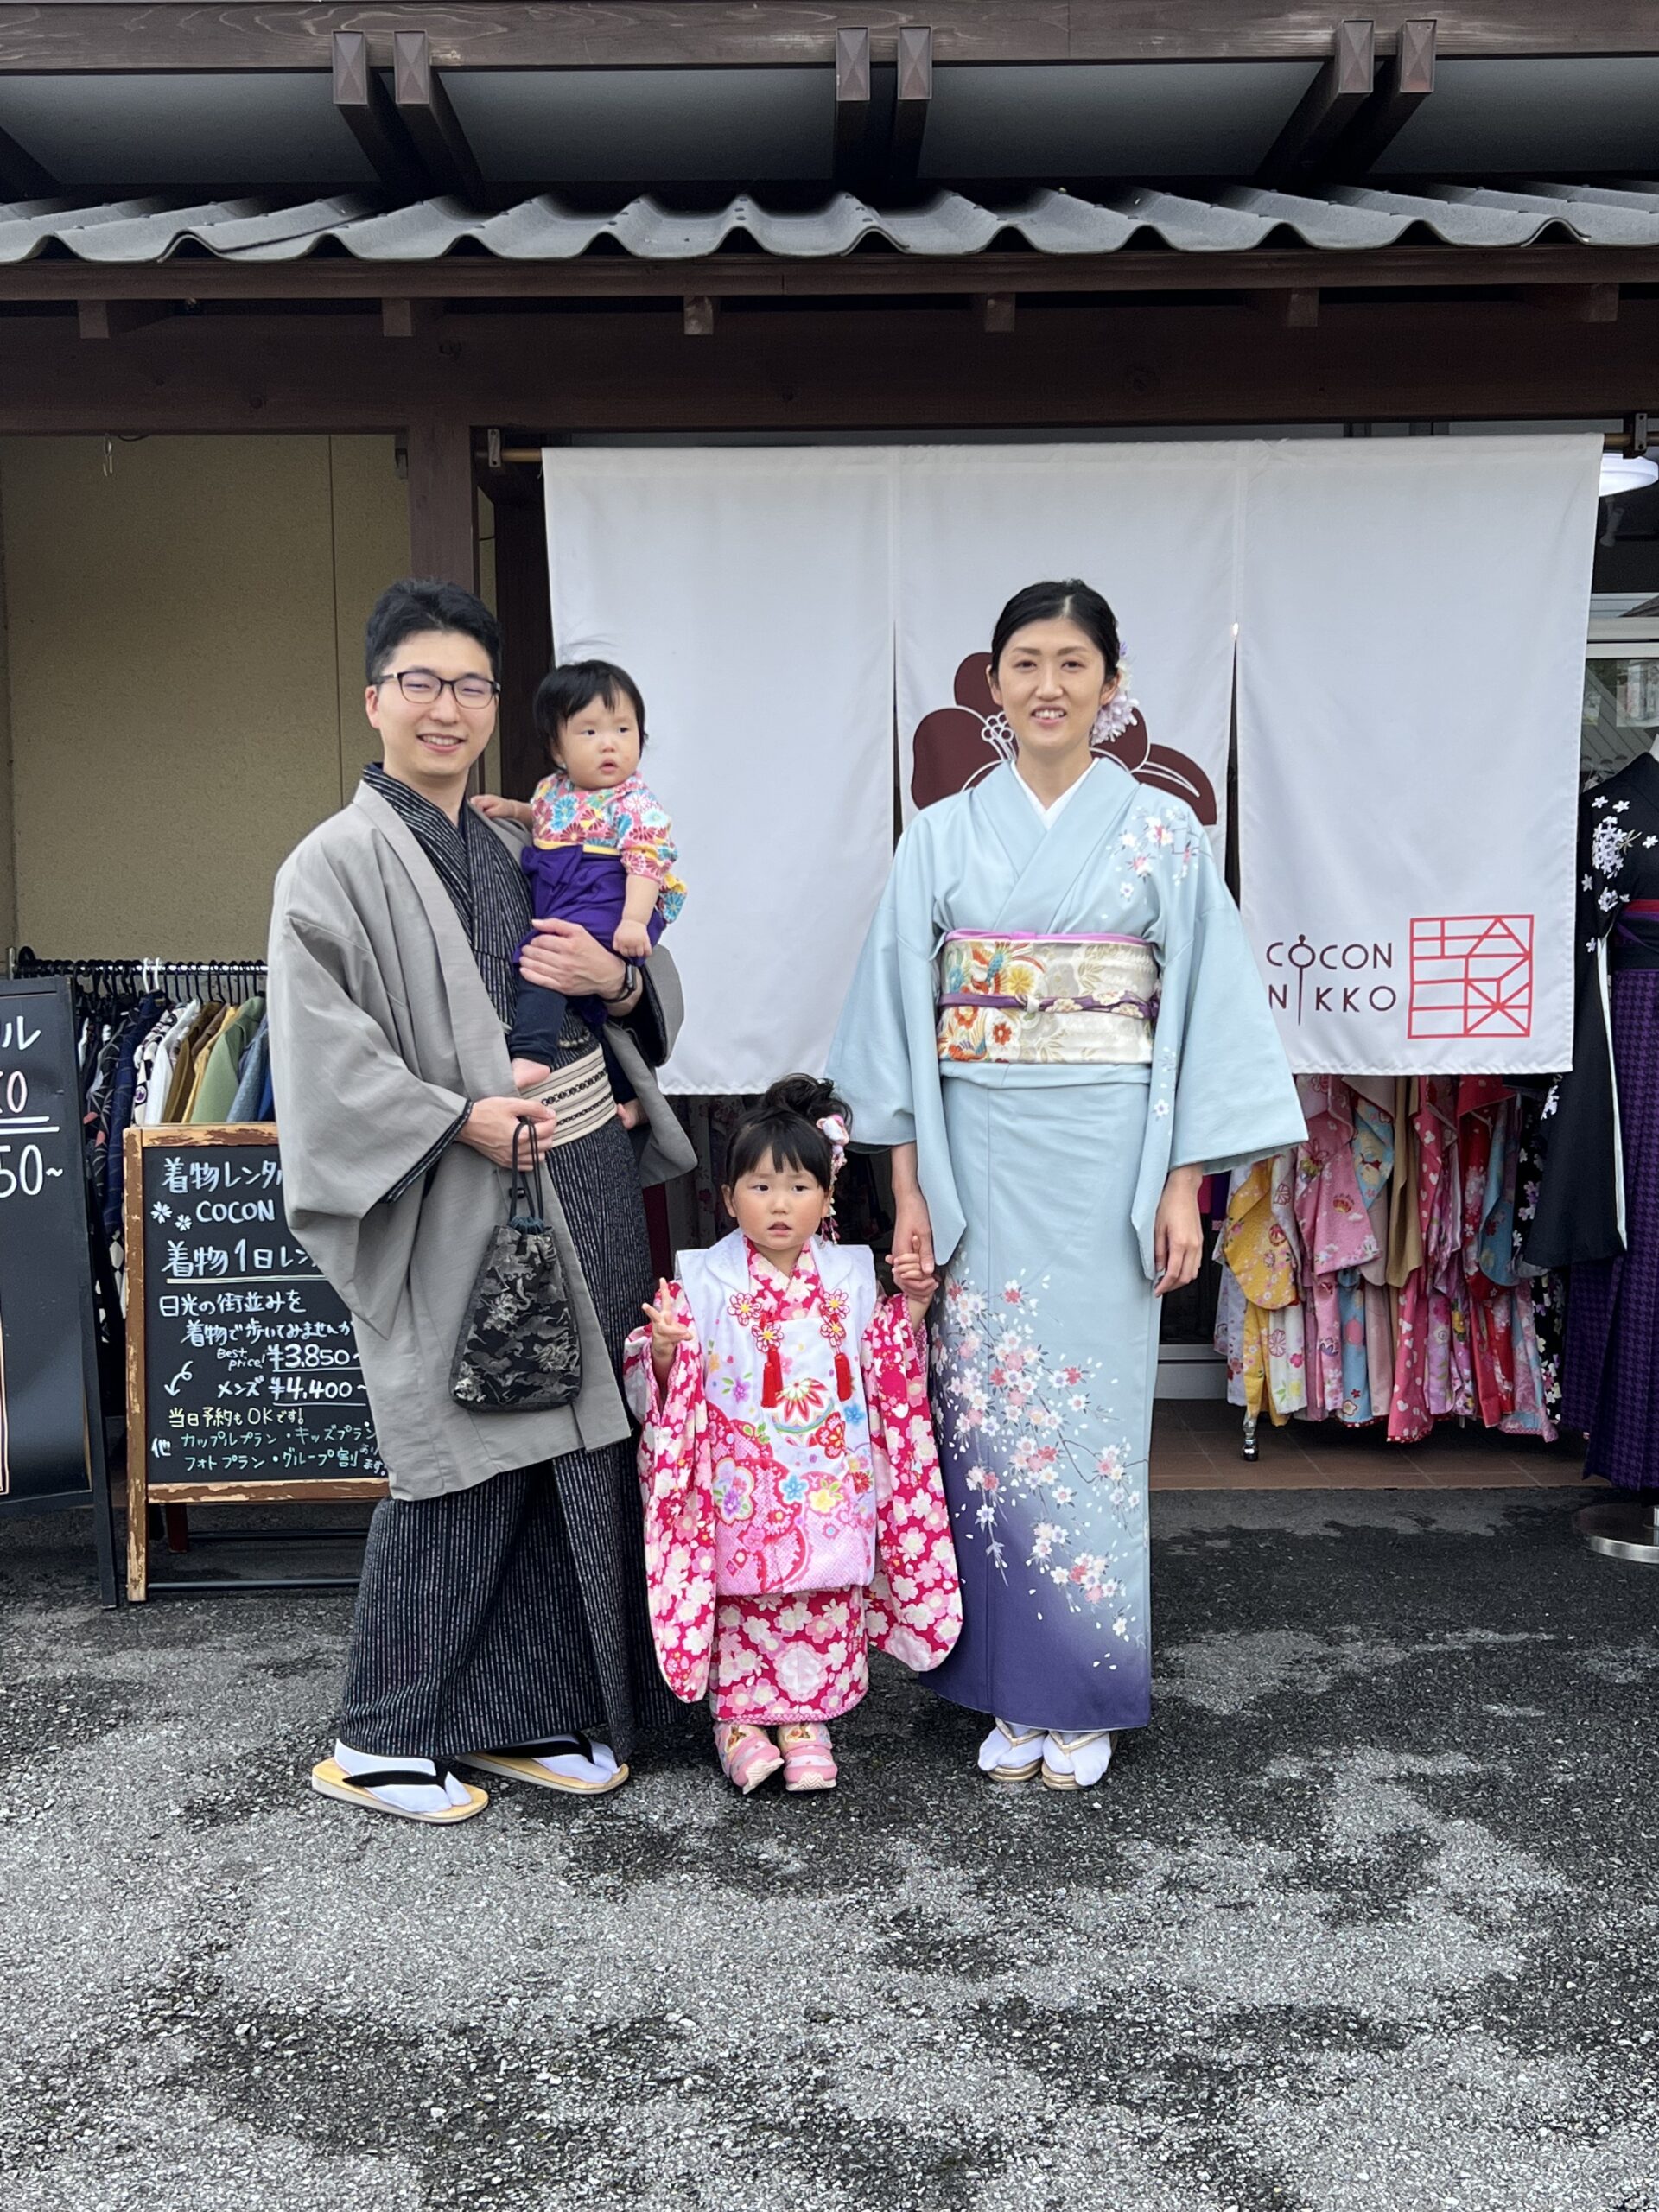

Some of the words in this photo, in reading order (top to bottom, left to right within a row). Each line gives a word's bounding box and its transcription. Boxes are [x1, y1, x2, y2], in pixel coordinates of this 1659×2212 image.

[1267, 935, 1392, 970] COCON
[1268, 983, 1396, 1025] NIKKO
[195, 1198, 276, 1224] COCON
[162, 1238, 317, 1277] 着物1日レン
[159, 1289, 307, 1318] 日光の街並みを
[180, 1318, 354, 1348] 着物で歩いてみませんか
[216, 1346, 248, 1360] Best
[217, 1375, 264, 1398] メンズ
[150, 1437, 172, 1459] 他
